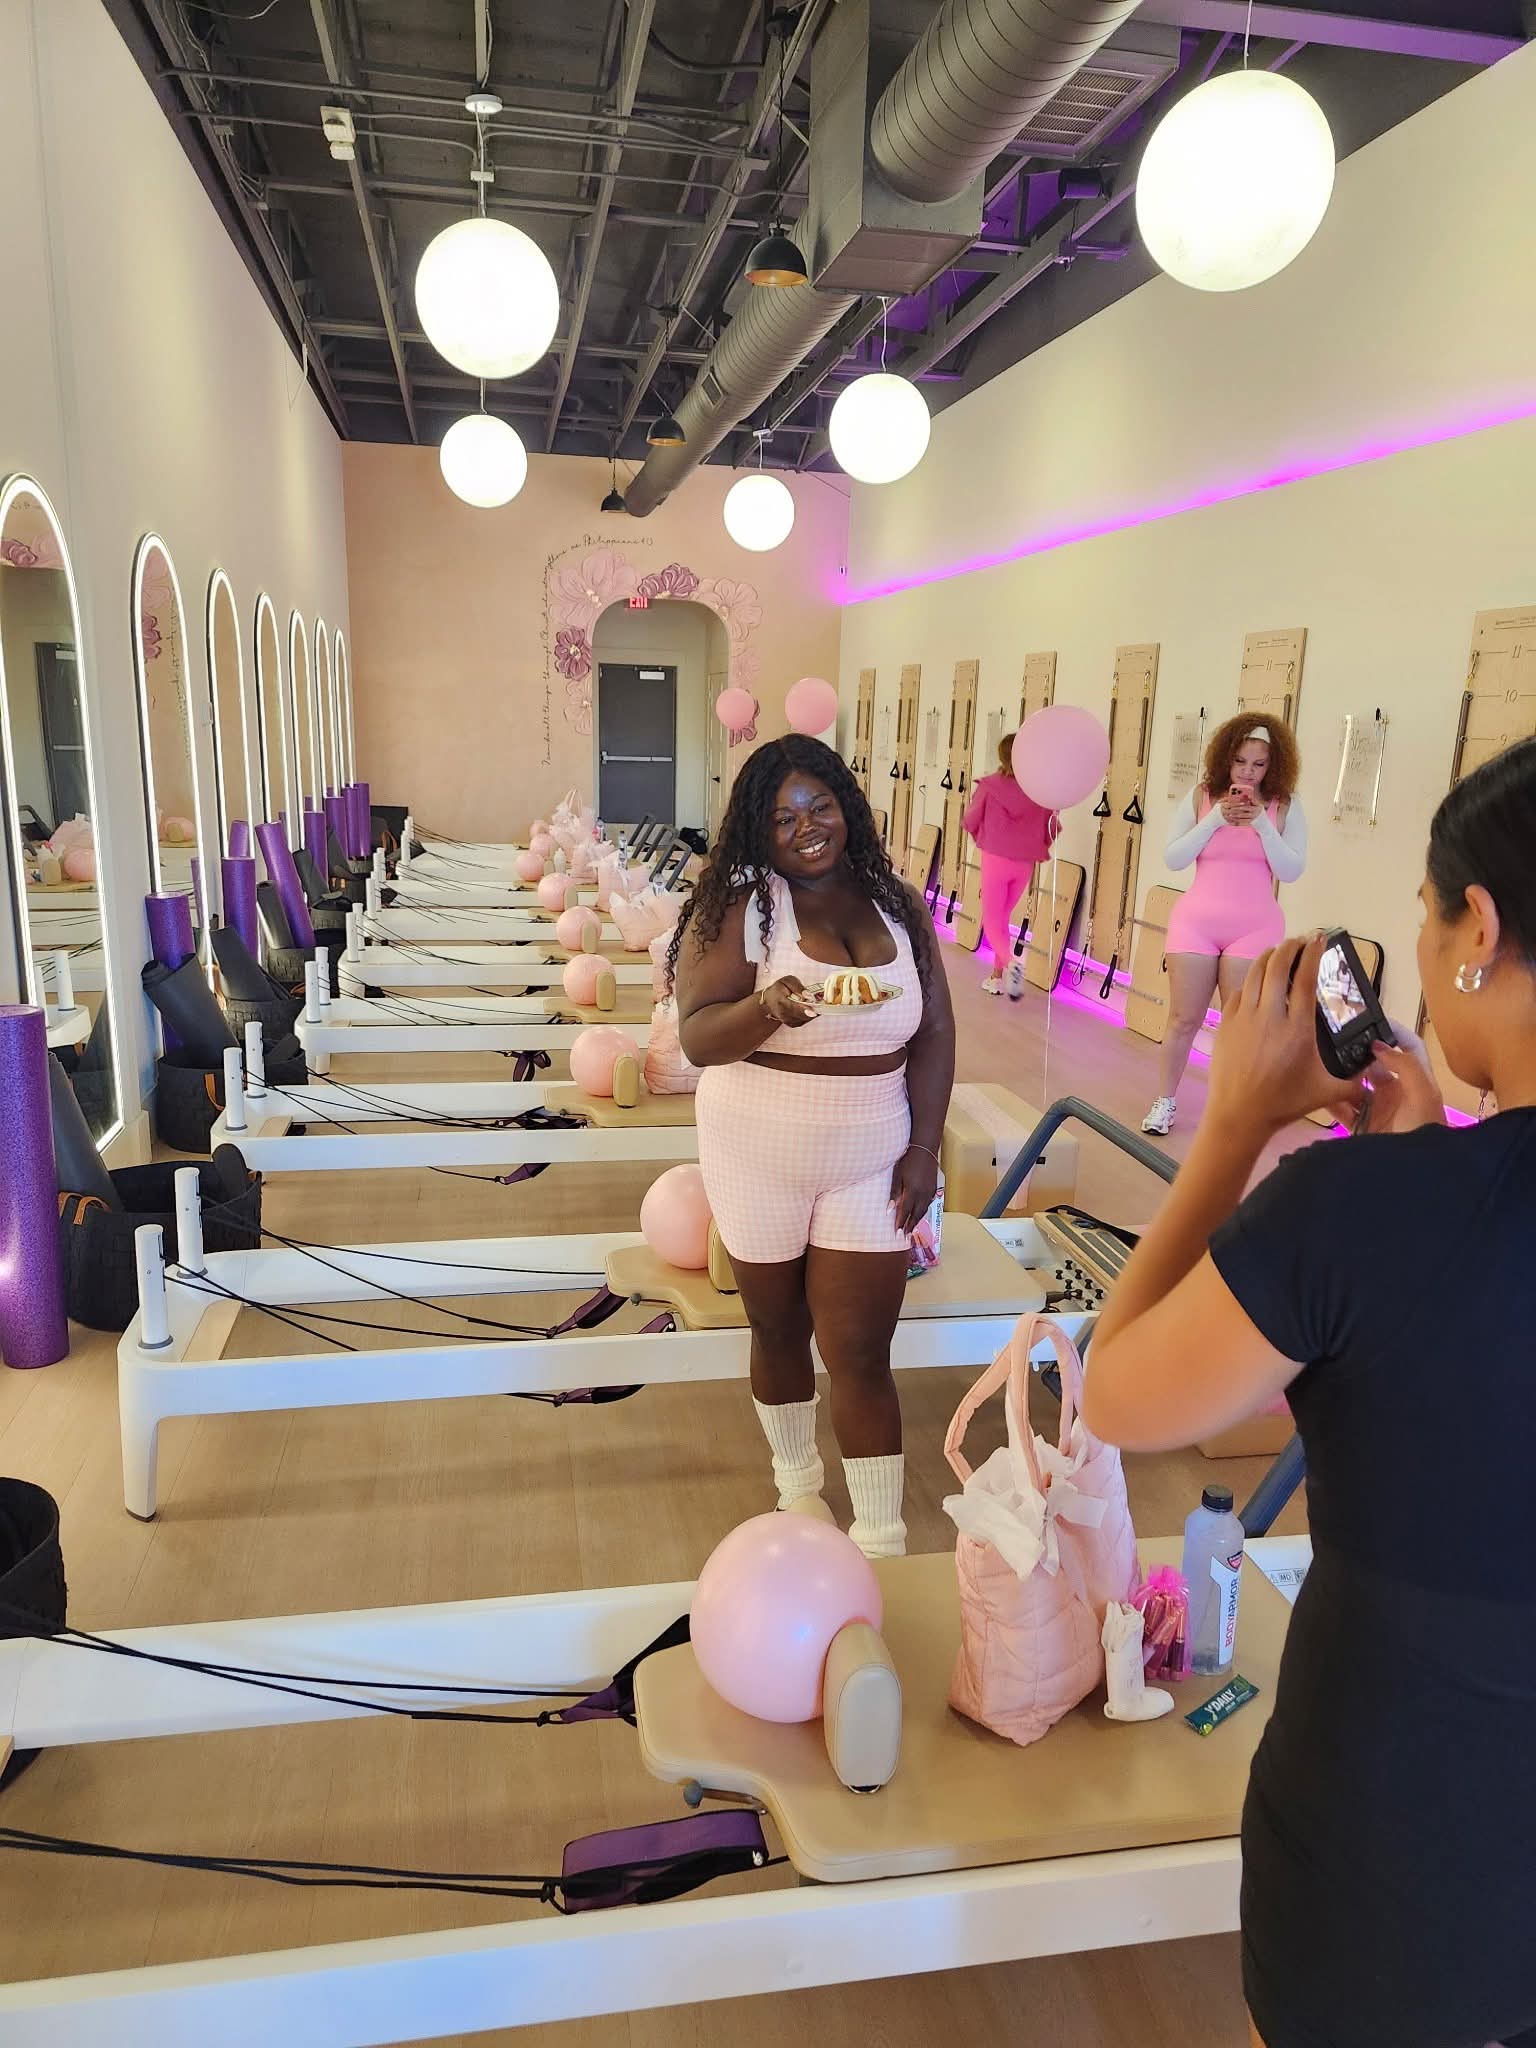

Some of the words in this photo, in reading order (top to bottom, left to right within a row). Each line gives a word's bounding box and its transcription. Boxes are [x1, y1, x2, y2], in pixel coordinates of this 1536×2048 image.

[1505, 689, 1518, 704] 10
[1500, 734, 1508, 746] 9
[1224, 1577, 1238, 1647] BODYARMOR
